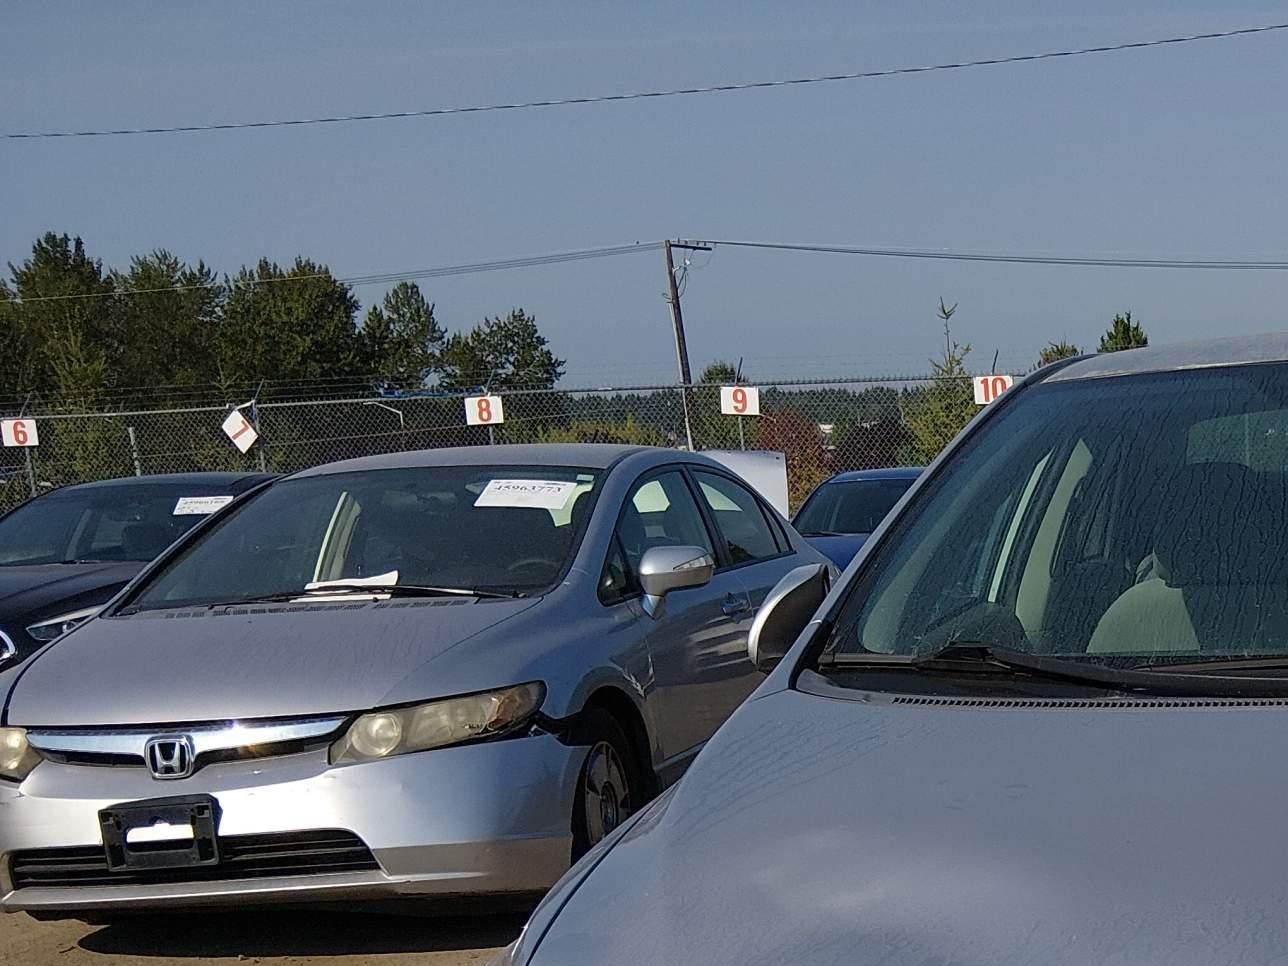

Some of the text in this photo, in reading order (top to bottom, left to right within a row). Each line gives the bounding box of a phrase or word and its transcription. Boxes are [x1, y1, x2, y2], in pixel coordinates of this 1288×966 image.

[732, 388, 748, 413] 9
[981, 377, 1007, 402] 10
[477, 399, 492, 422] 8
[13, 421, 29, 445] 6
[232, 420, 249, 440] 7
